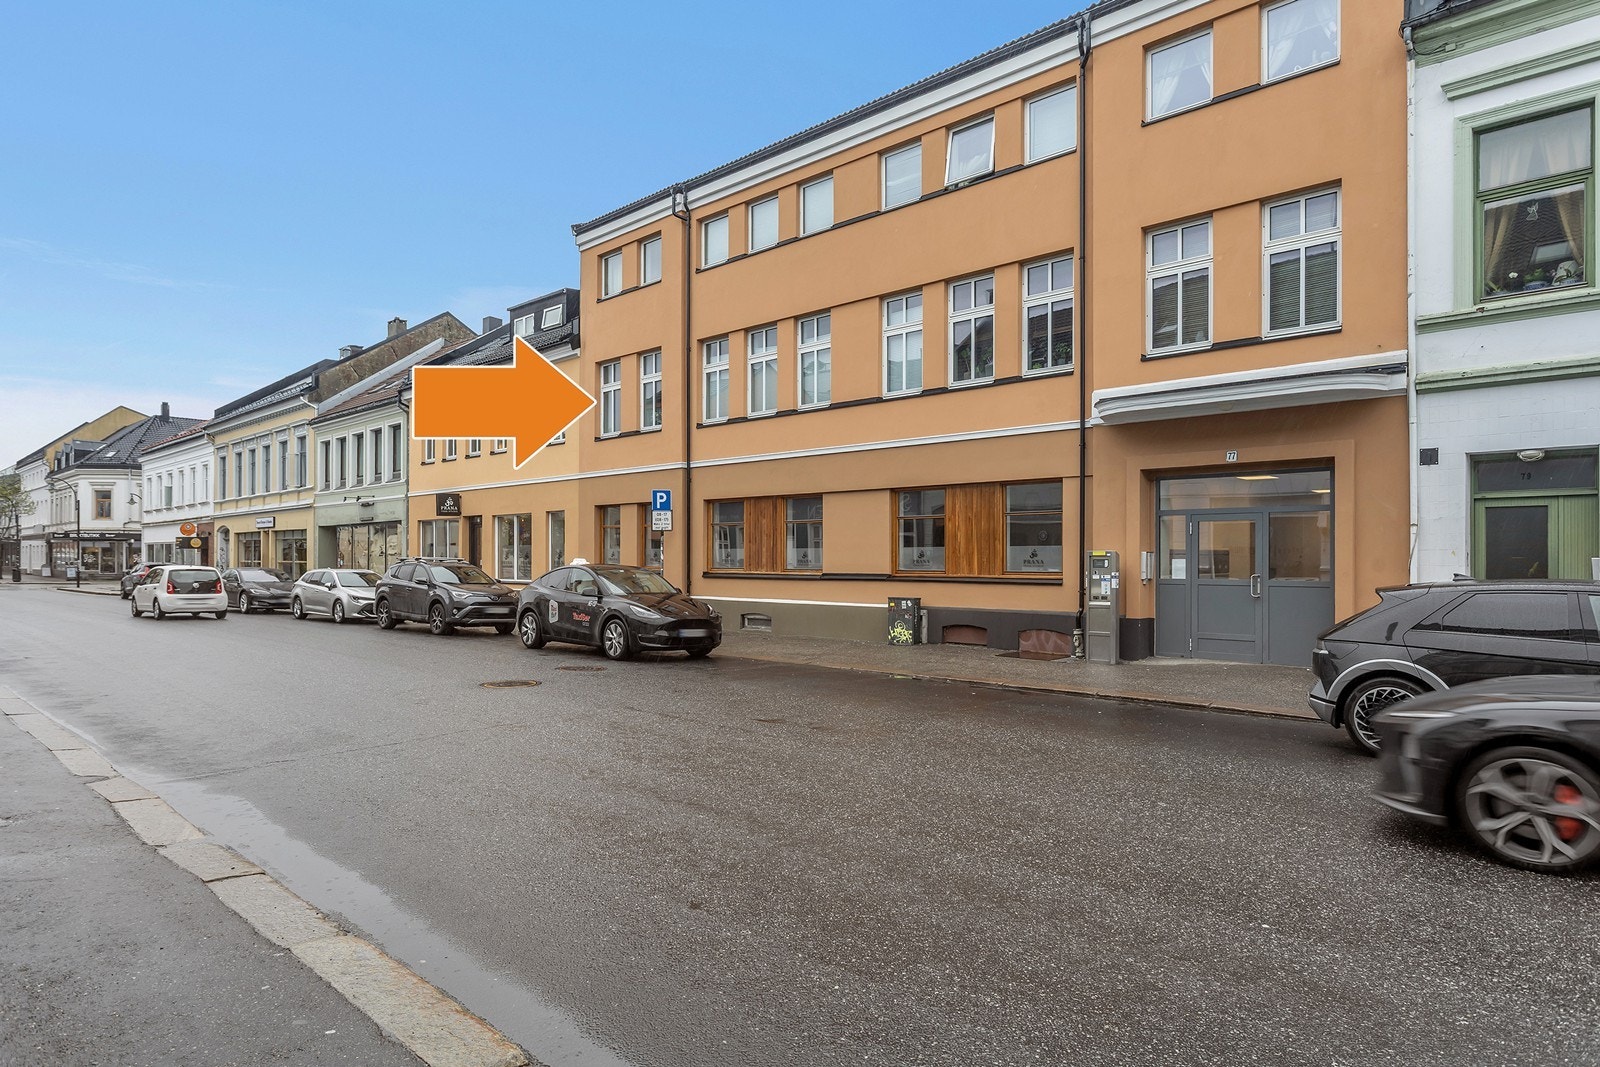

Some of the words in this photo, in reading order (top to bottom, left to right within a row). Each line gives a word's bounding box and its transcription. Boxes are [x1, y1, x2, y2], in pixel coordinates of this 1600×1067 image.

[1227, 451, 1236, 460] 77
[1520, 472, 1531, 480] 79
[657, 493, 667, 508] P
